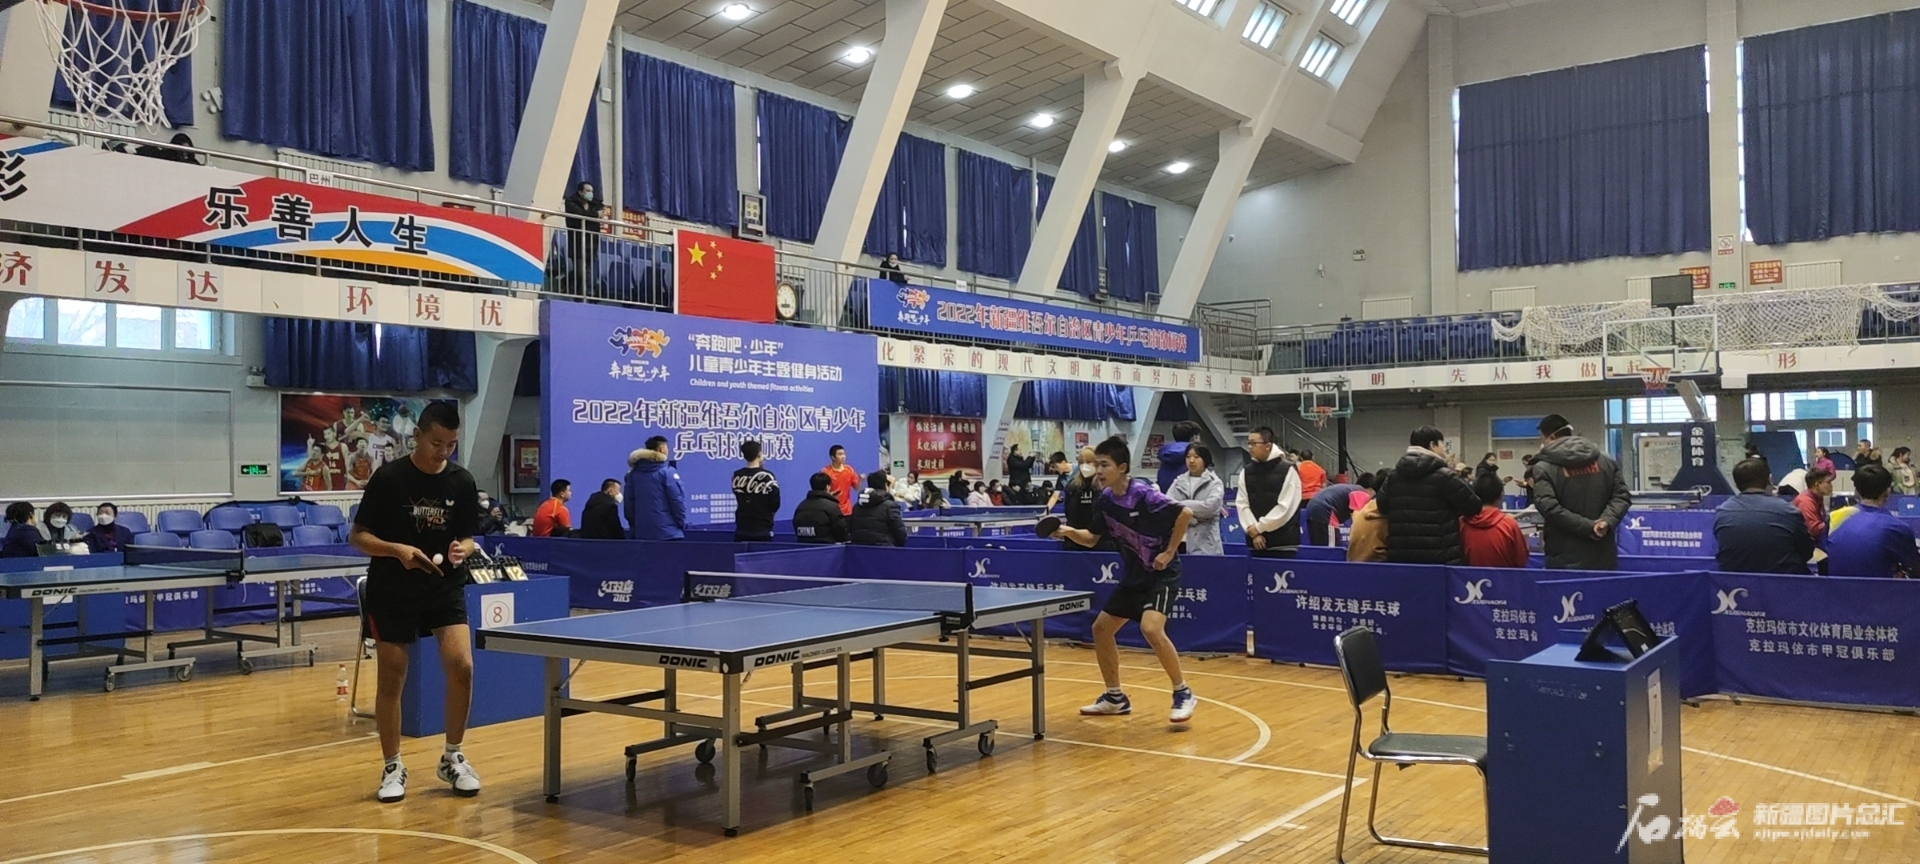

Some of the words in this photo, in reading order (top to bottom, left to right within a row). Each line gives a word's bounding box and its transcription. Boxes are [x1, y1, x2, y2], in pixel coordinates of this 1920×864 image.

[310, 173, 331, 186] 巴州
[205, 186, 428, 256] 乐善人生
[937, 300, 1187, 354] 2022年新疆维吾尔自治区青少年乒乓球锦标赛
[689, 354, 843, 382] 儿童青少年主题健身活动
[689, 378, 716, 387] Children
[716, 380, 728, 388] and
[729, 380, 747, 390] youth
[747, 381, 770, 391] themed
[770, 383, 789, 392] fitness
[789, 384, 814, 393] activities
[573, 398, 867, 434] 2022年新疆维吾尔自治区青少年
[413, 505, 444, 517] BUTTERFLY
[797, 527, 816, 537] CHINA
[31, 587, 77, 596] DONIC
[600, 579, 635, 594] 红双喜
[613, 594, 632, 603] DHS
[1058, 600, 1085, 612] DONIC
[1296, 594, 1401, 617] 许绍发无缝乒乓球
[493, 606, 502, 623] 8
[1492, 608, 1537, 625] 克拉玛依市
[1723, 609, 1766, 617] XUSHAOFA
[1745, 617, 1899, 643] 克拉玛依市文化体育局业余体校
[1748, 638, 1896, 662] 克拉玛依市甲冠俱乐部
[658, 655, 708, 669] DONIC
[754, 650, 800, 668] DONIC
